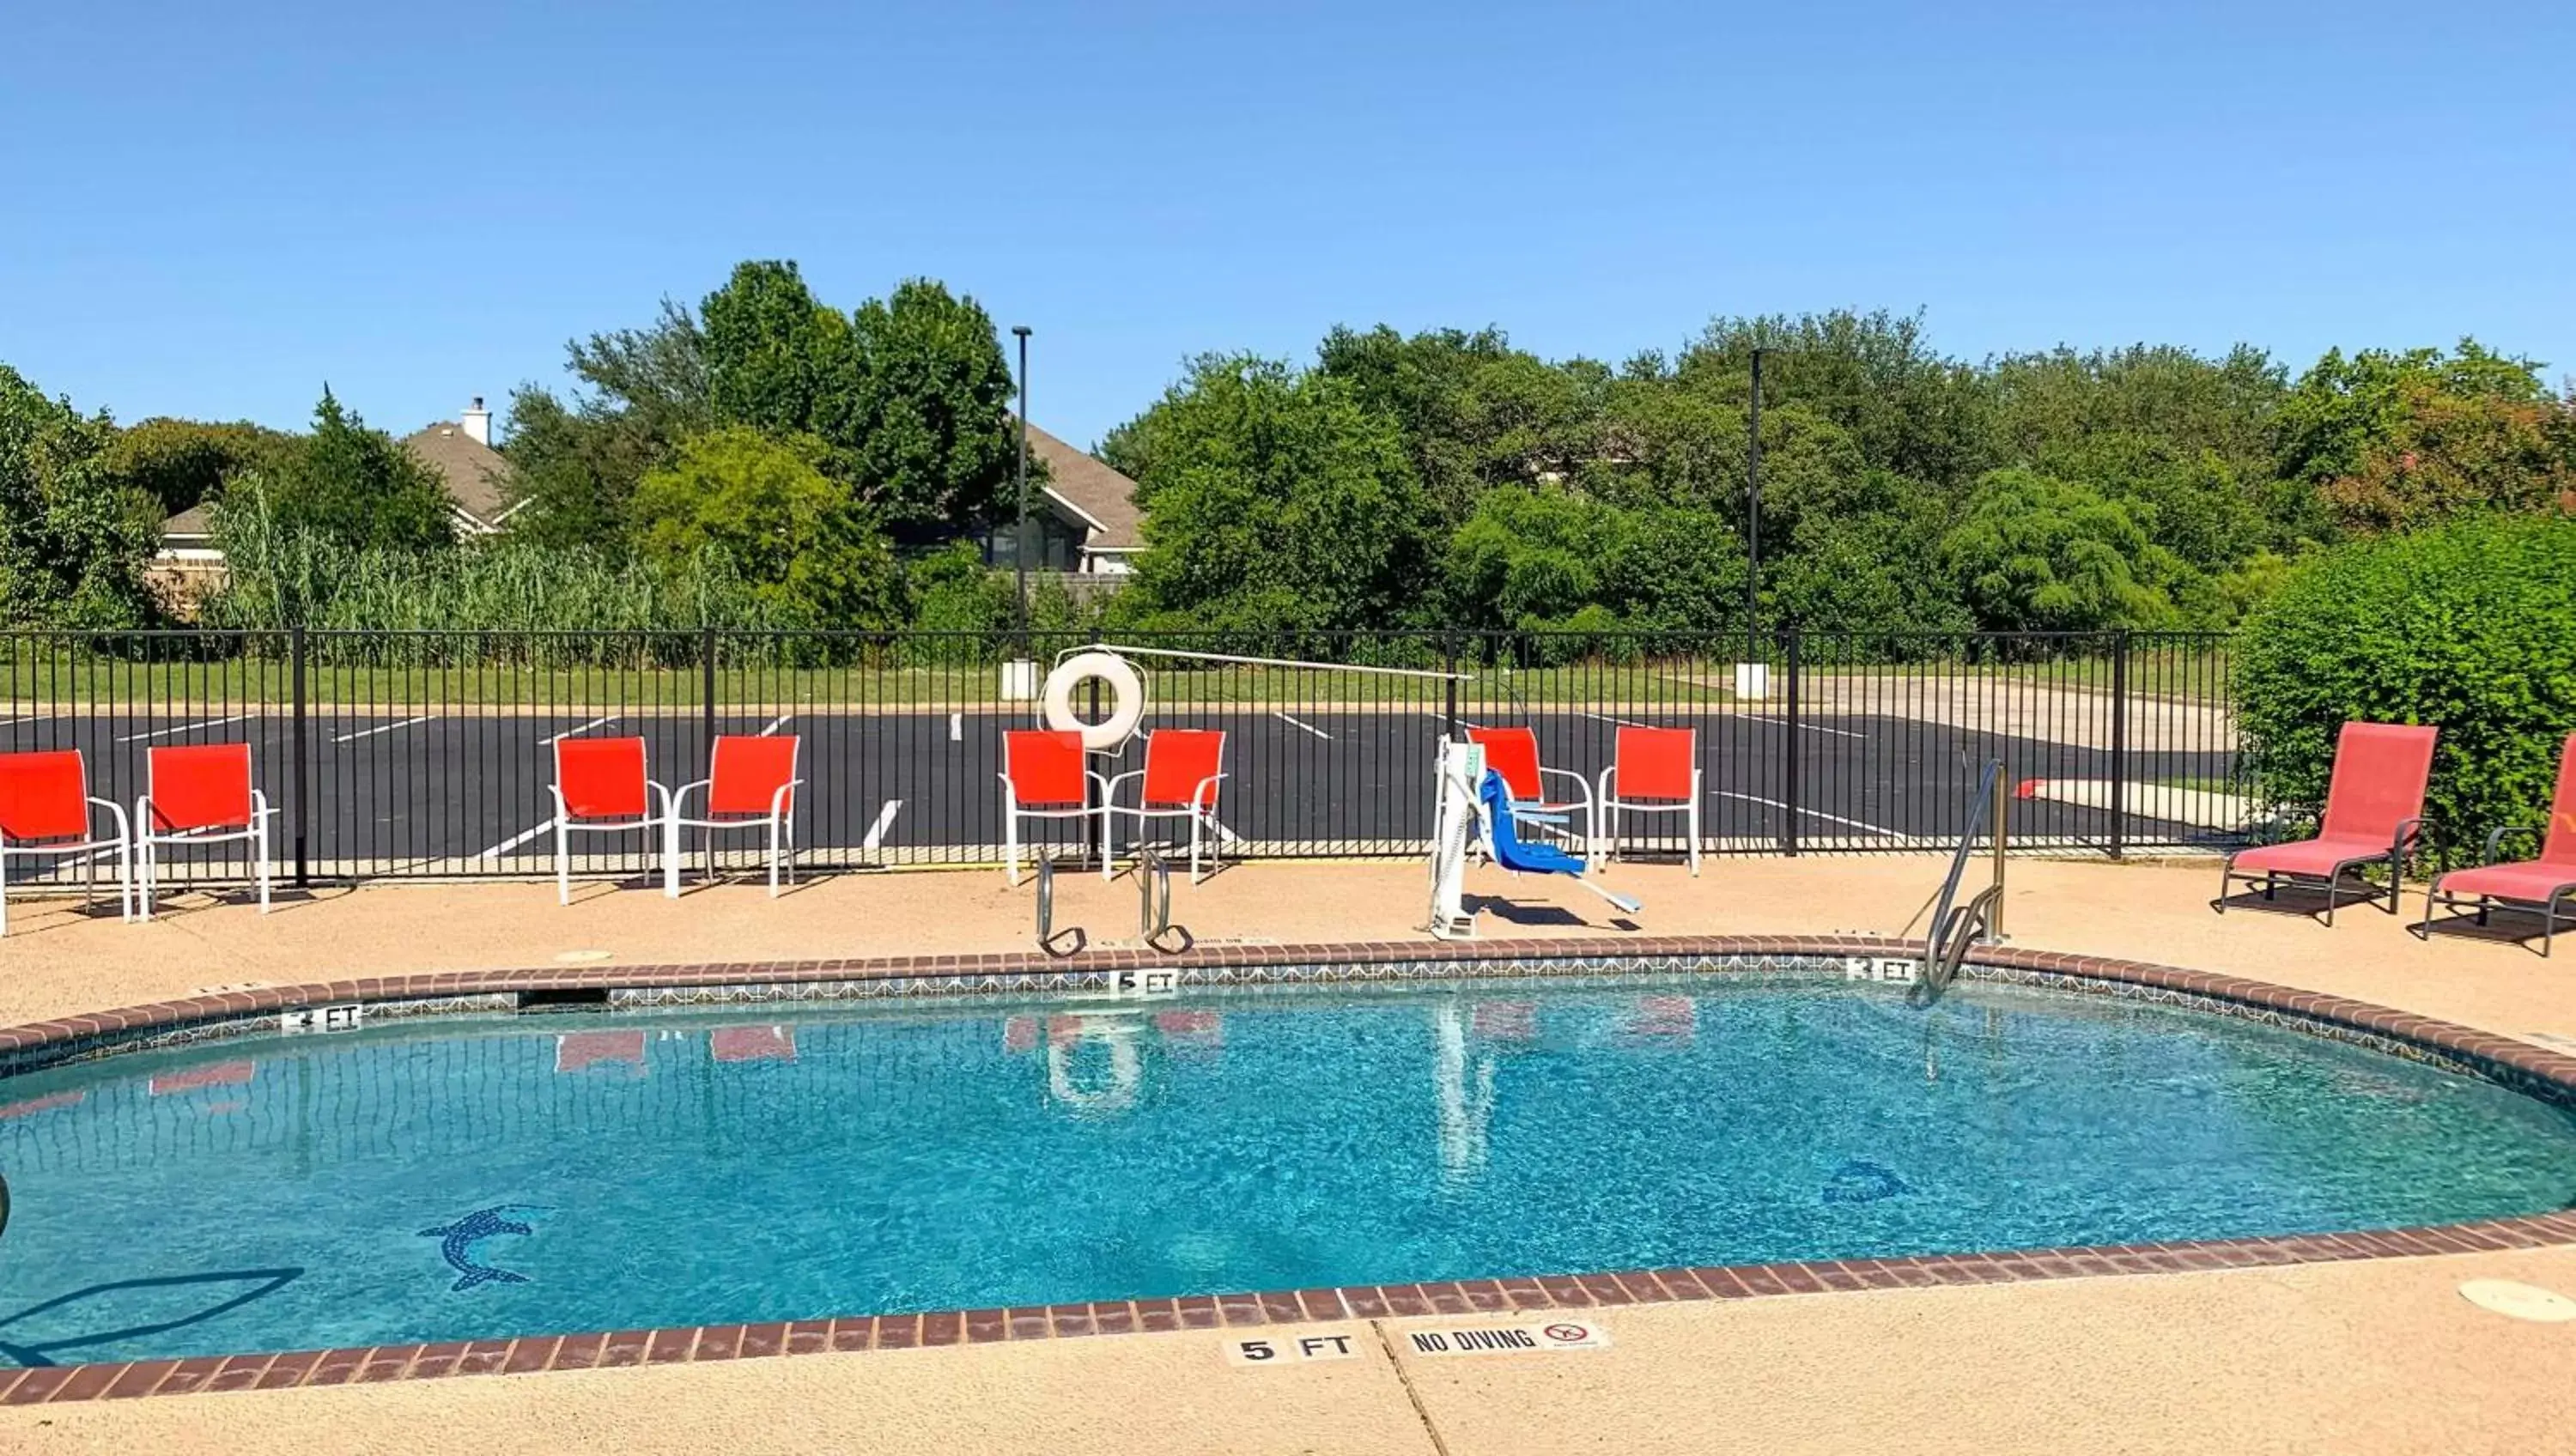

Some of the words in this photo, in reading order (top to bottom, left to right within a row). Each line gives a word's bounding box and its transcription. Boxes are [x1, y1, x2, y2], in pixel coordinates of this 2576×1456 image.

[1884, 962, 1911, 975] FT
[1119, 971, 1136, 988] 5
[1146, 974, 1173, 987] FT
[326, 1006, 357, 1026] FT
[1240, 1341, 1275, 1361] 5
[1300, 1335, 1352, 1357] FT
[1411, 1332, 1449, 1352] NO
[1451, 1328, 1536, 1351] DIVING
